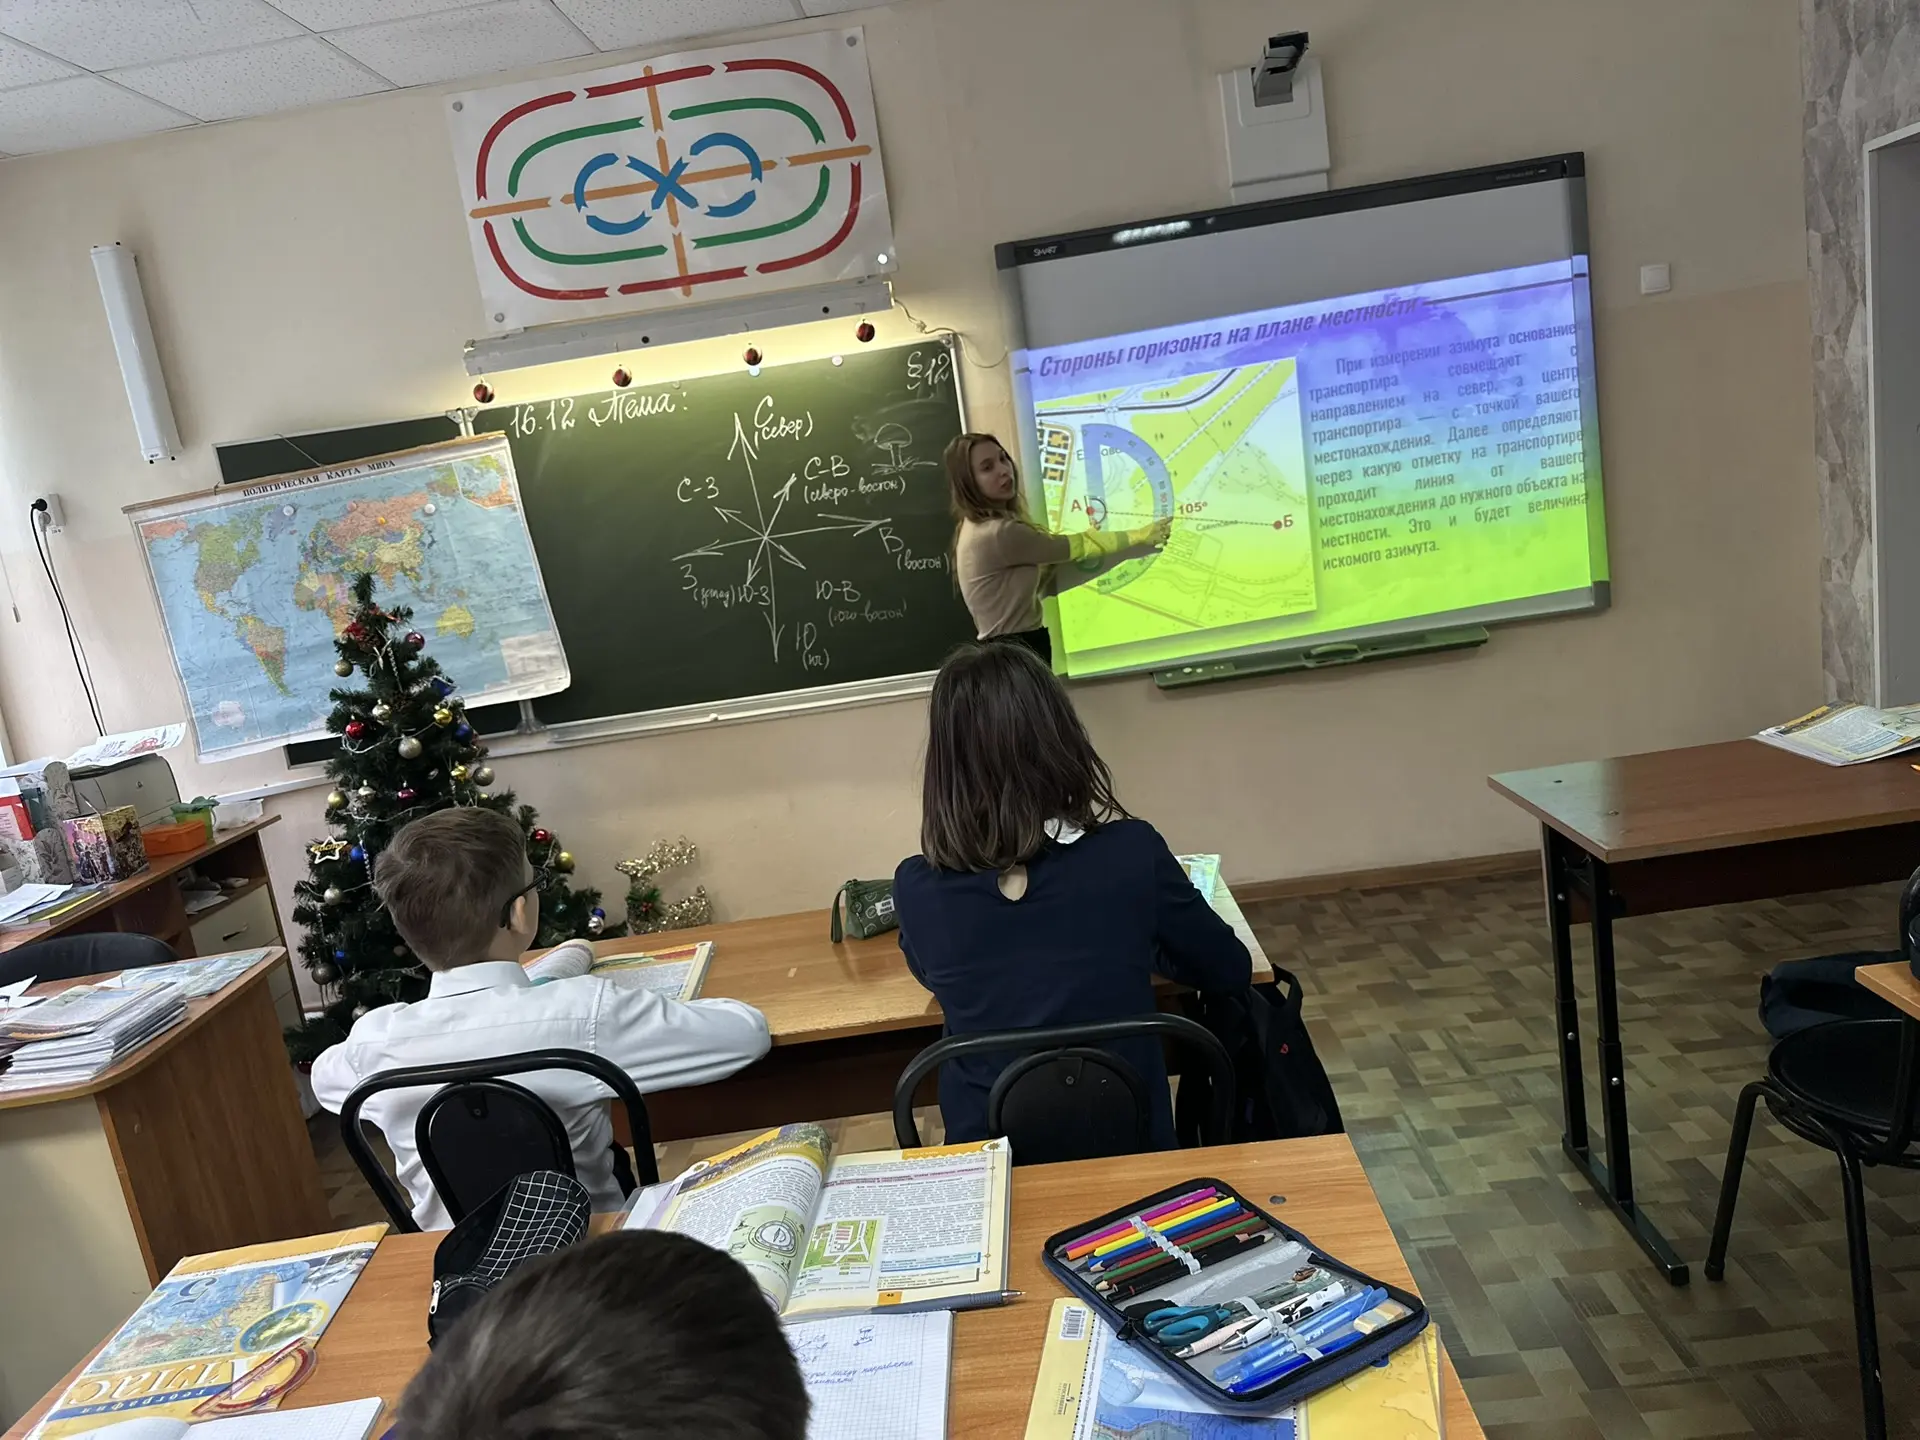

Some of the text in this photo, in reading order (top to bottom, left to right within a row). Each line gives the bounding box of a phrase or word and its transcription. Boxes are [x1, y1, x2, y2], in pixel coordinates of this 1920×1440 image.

[1033, 245, 1058, 257] SMART
[1040, 298, 1417, 377] Стороны горизонта на плане местности
[1336, 323, 1579, 376] При измерении азимута основание
[1309, 345, 1578, 402] транспортира совмещают с
[1310, 396, 1405, 422] направлением
[1423, 391, 1440, 404] на
[1515, 378, 1524, 388] а
[1542, 366, 1580, 384] центр
[510, 398, 576, 439] 16.12
[754, 394, 775, 429] С
[1312, 419, 1402, 444] транспортира
[1452, 407, 1460, 419] с
[1476, 397, 1519, 415] точкой
[1536, 389, 1581, 407] вашего
[1314, 435, 1435, 466] местонахождения.
[1447, 425, 1489, 444] Далее
[1315, 429, 1584, 488] через какую отметку на транспортире
[243, 459, 396, 497] ПОЛИТИЧЕСКАЯ КАРТА МИРА
[1318, 452, 1584, 509] проходит линия от вашего
[1319, 473, 1588, 529] местонахождения до нужного объекта на
[1283, 514, 1294, 528] Б
[1321, 491, 1589, 549] местности. Это и будет величина
[1322, 540, 1440, 571] искомого азимута.
[80, 1387, 208, 1415] география
